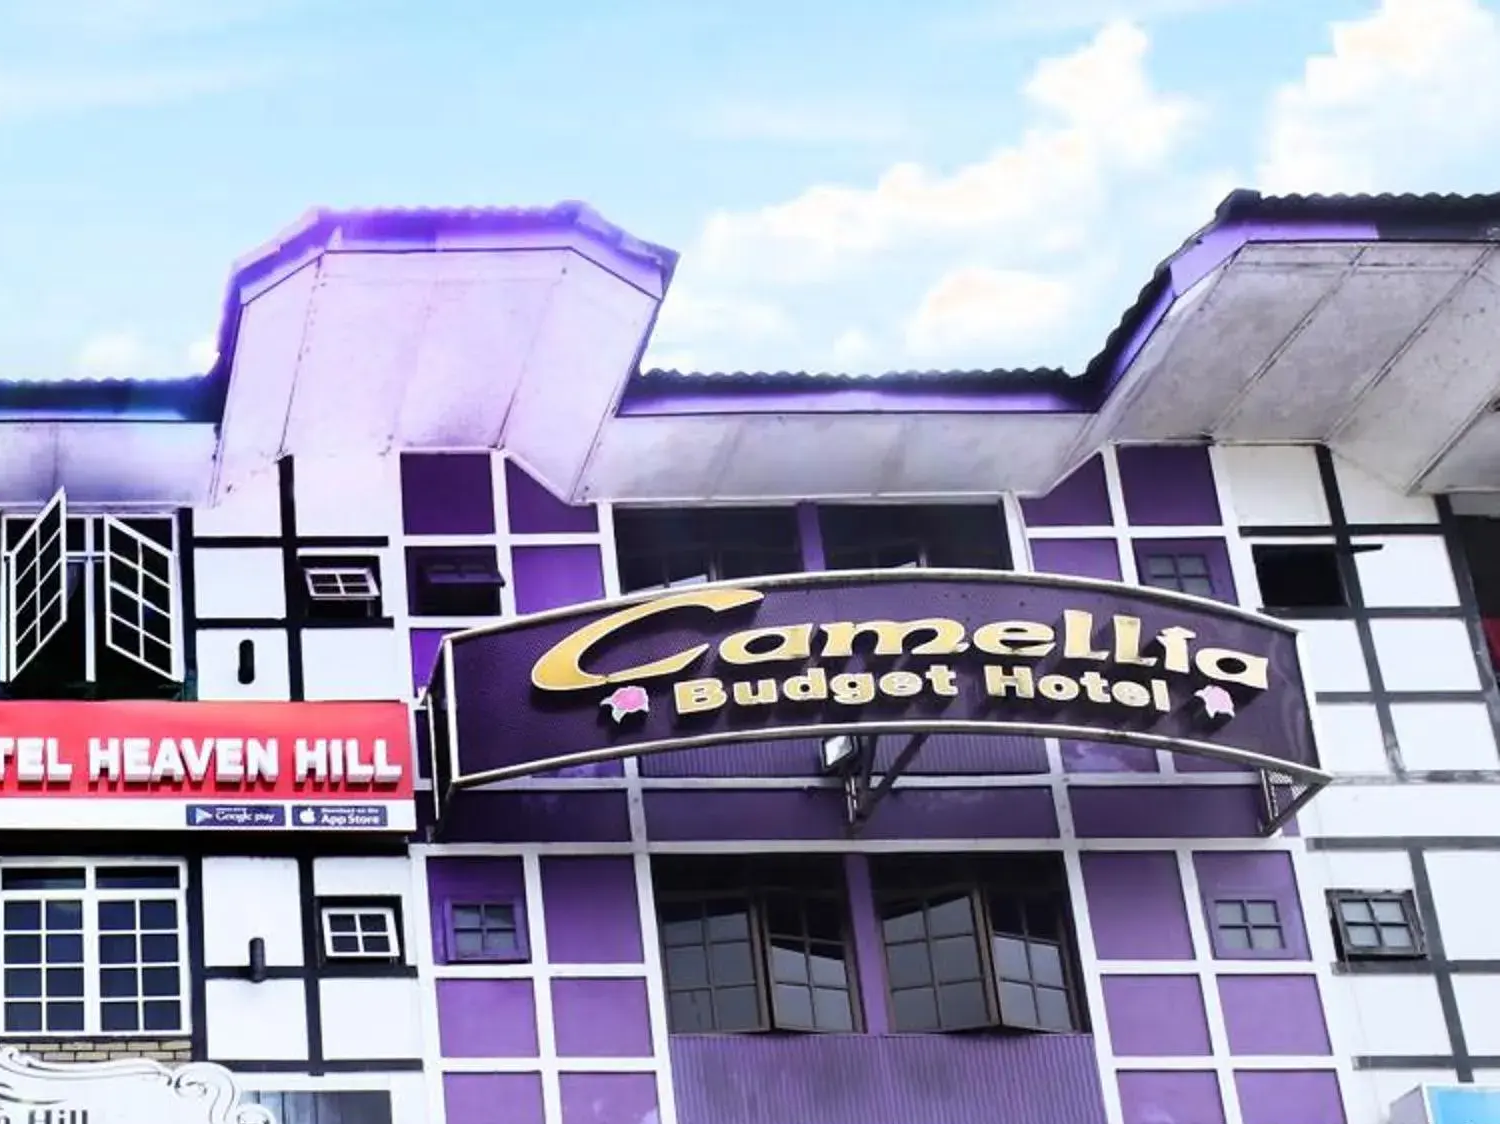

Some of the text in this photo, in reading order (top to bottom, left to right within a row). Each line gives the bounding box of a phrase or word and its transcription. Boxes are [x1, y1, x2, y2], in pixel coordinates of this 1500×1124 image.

[675, 666, 1172, 716] Budget Hotel
[88, 738, 279, 784] HEAVEN
[294, 738, 402, 783] HILL
[321, 815, 381, 827] App Store
